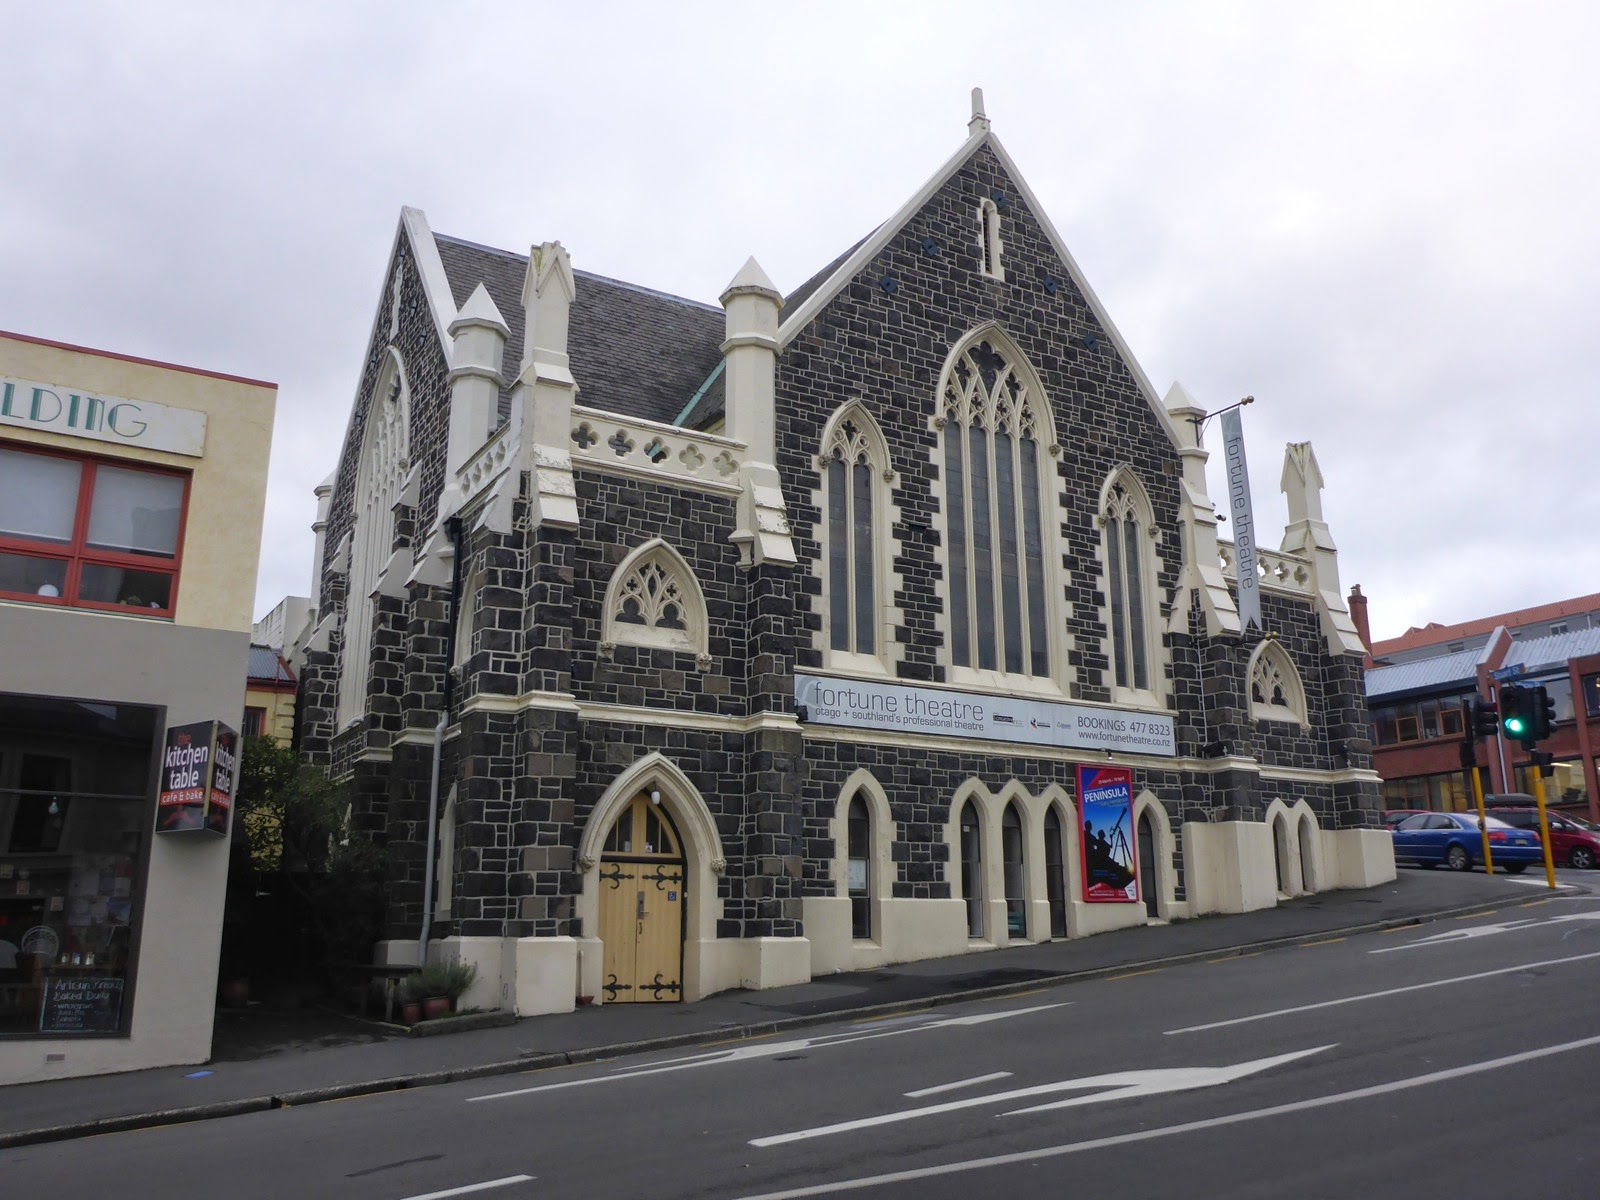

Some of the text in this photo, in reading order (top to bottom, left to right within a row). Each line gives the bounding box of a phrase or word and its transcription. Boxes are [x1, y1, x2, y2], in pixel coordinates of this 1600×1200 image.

[1227, 437, 1253, 590] fortune theatre
[815, 681, 897, 713] fortune
[905, 693, 984, 721] theatre
[815, 707, 841, 719] otago
[852, 711, 901, 724] southland's
[903, 716, 953, 728] professional
[954, 721, 984, 731] theatre
[1077, 716, 1126, 732] BOOKINGS
[1130, 722, 1146, 733] 477
[1148, 723, 1171, 736] 8323
[1078, 730, 1171, 747] www.fortunetheatre.co.nz
[165, 743, 209, 768] kitchen
[214, 740, 235, 772] kitchen
[169, 767, 199, 790] table
[215, 769, 230, 793] table
[162, 791, 203, 802] cafe & bake
[1084, 787, 1128, 803] PENINSULA
